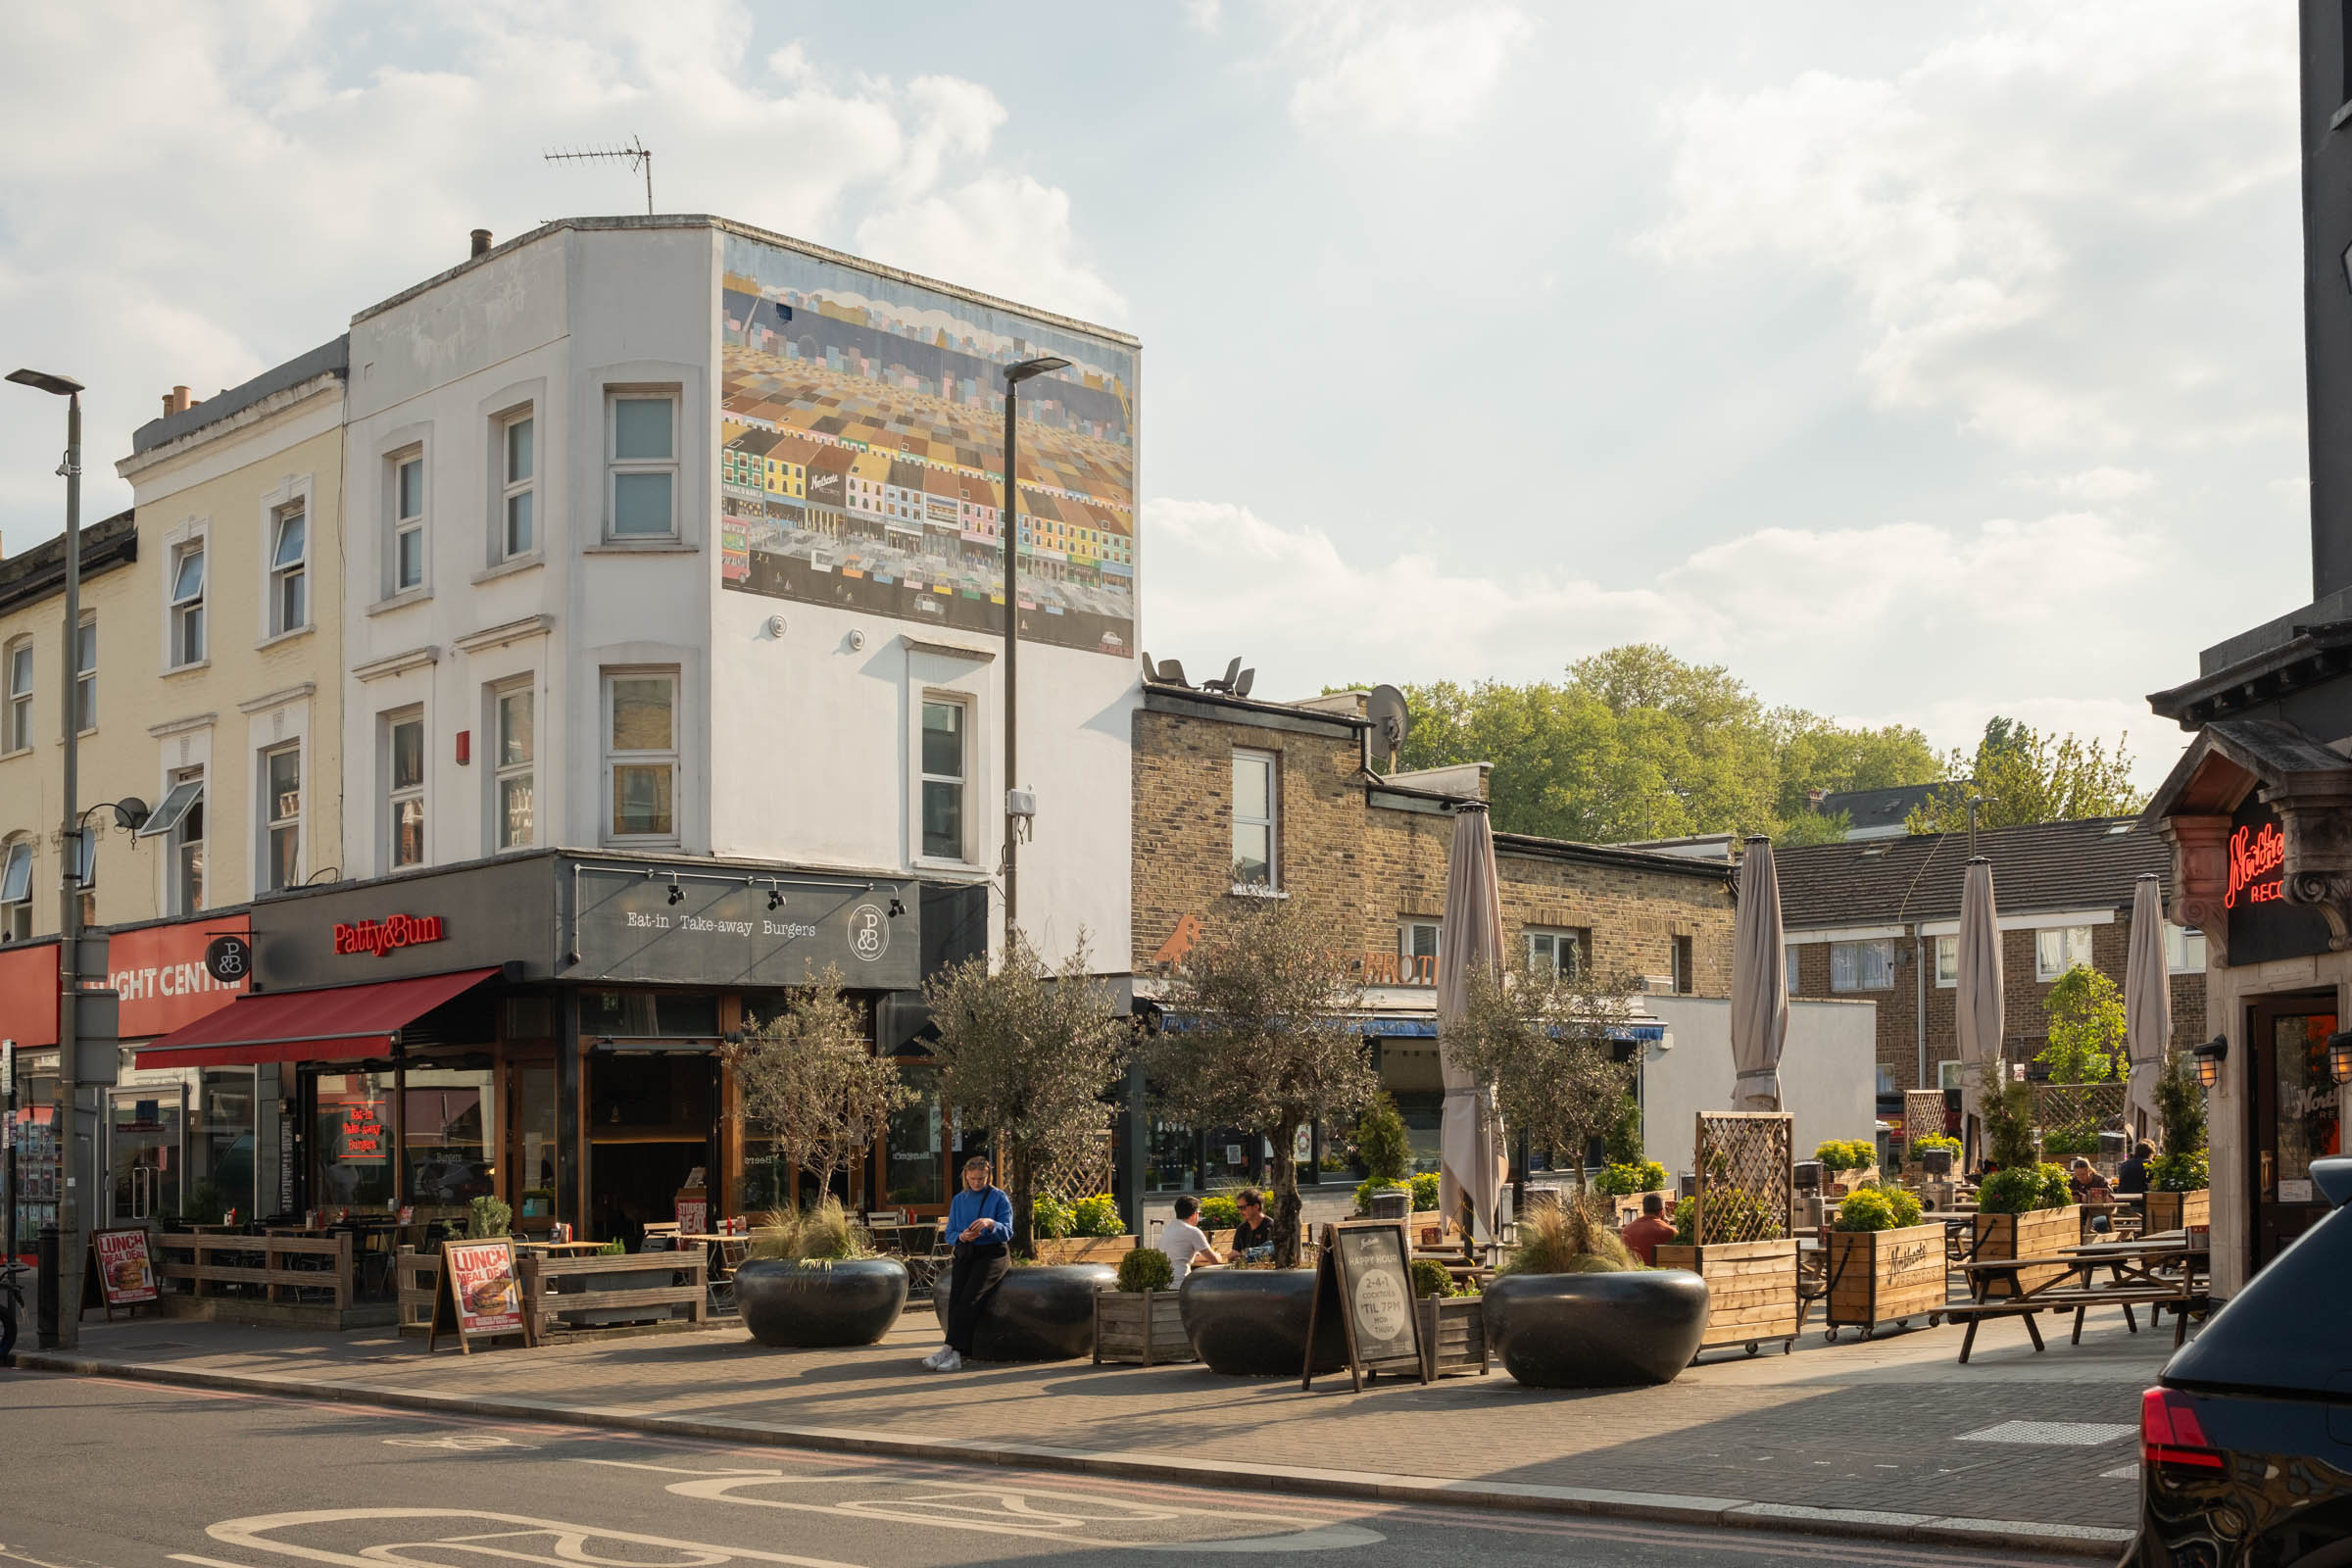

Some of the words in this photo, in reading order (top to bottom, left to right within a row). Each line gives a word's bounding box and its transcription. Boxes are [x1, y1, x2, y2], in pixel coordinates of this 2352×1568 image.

[626, 911, 670, 929] Eat-in
[680, 915, 753, 937] Take-away
[762, 919, 816, 939] Burgers
[331, 912, 443, 957] Patty&Bun
[89, 966, 158, 1002] IGHT
[350, 1107, 373, 1120] Eat-in
[342, 1122, 381, 1137] Take-away
[348, 1138, 377, 1152] Burgers
[98, 1234, 145, 1254] LUNCH
[102, 1252, 125, 1263] MEAL
[125, 1250, 146, 1261] DEAL
[452, 1249, 509, 1272] LUNCH
[1348, 1255, 1375, 1267] HAPPY
[1376, 1253, 1398, 1264] HOUR
[456, 1271, 485, 1284] MEAL
[486, 1268, 512, 1281] DEAL
[1365, 1275, 1389, 1289] 2-4-1
[1381, 1300, 1401, 1312] 7PM
